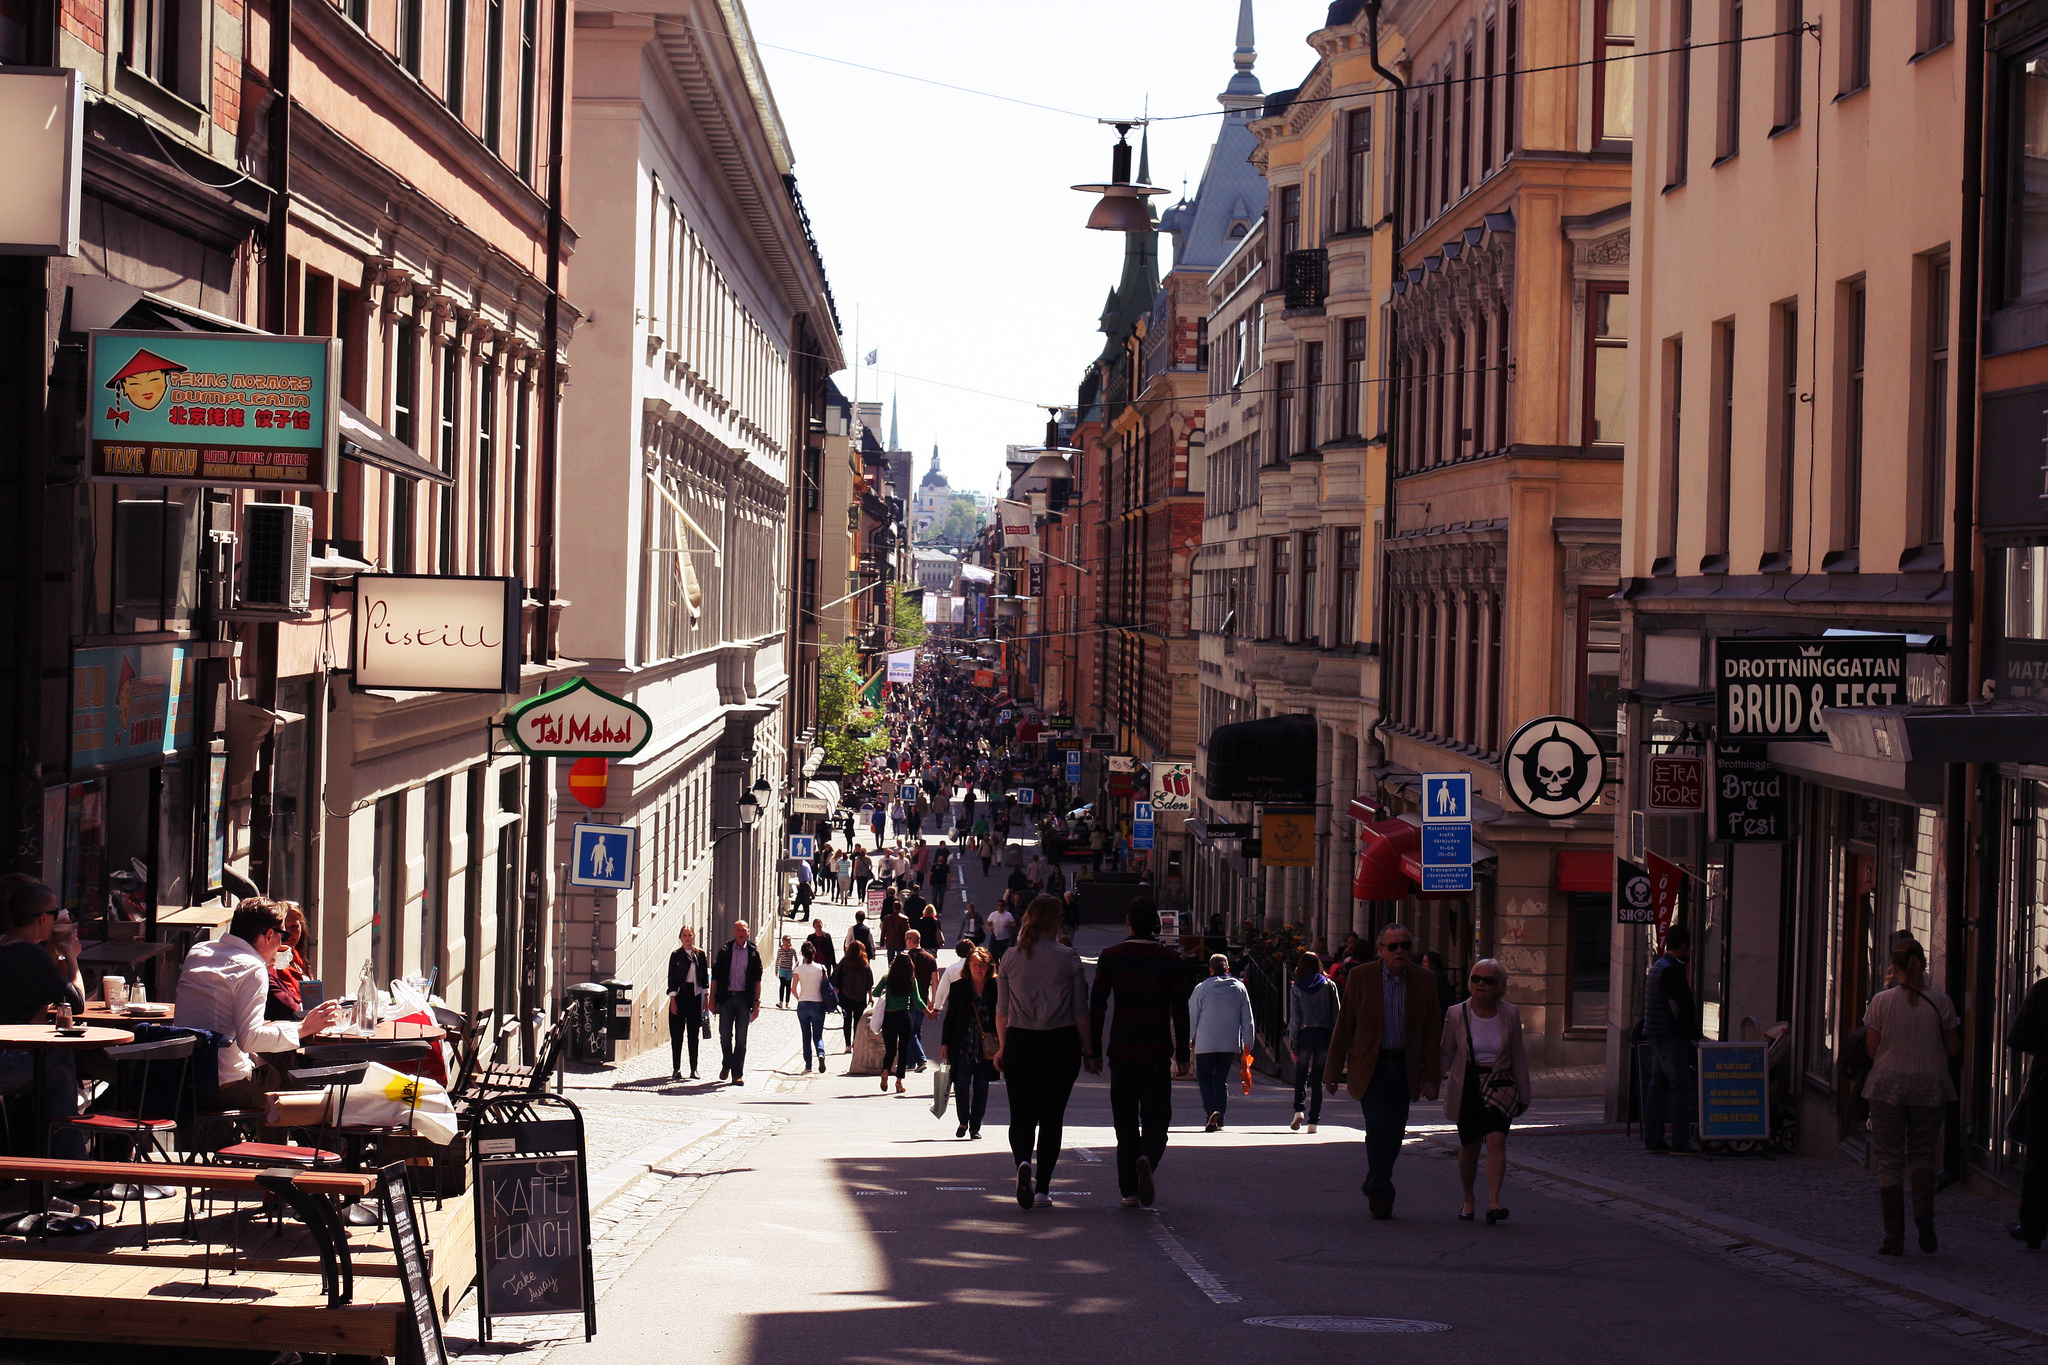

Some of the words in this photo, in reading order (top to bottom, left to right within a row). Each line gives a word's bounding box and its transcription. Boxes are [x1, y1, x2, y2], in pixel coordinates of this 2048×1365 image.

[170, 372, 227, 388] PEKING
[231, 374, 312, 391] MORMORS
[168, 406, 245, 427] 北京姥姥
[254, 409, 311, 430] 饺子馆
[103, 446, 145, 473] TAKE
[151, 448, 197, 476] AWAY
[204, 450, 228, 463] LUNCH
[273, 452, 308, 466] CATERING
[1032, 566, 1041, 594] PTK
[363, 595, 501, 670] Pistill
[1724, 658, 1900, 678] DROTTNINGGATAN
[1728, 683, 1803, 734] BRUD
[1809, 683, 1829, 734] &
[531, 713, 565, 744] Taj
[564, 714, 632, 744] Mahal
[1055, 740, 1080, 748] CARAT
[1670, 764, 1698, 782] TEA
[1654, 785, 1699, 803] STORE
[1722, 774, 1780, 799] Brud
[1151, 790, 1190, 810] Eden
[1746, 795, 1758, 810] &
[1728, 811, 1776, 837] Fest
[492, 1176, 569, 1218] KAFFE
[494, 1221, 571, 1260] LUNCH
[502, 1270, 537, 1296] Take
[529, 1275, 559, 1303] Away
